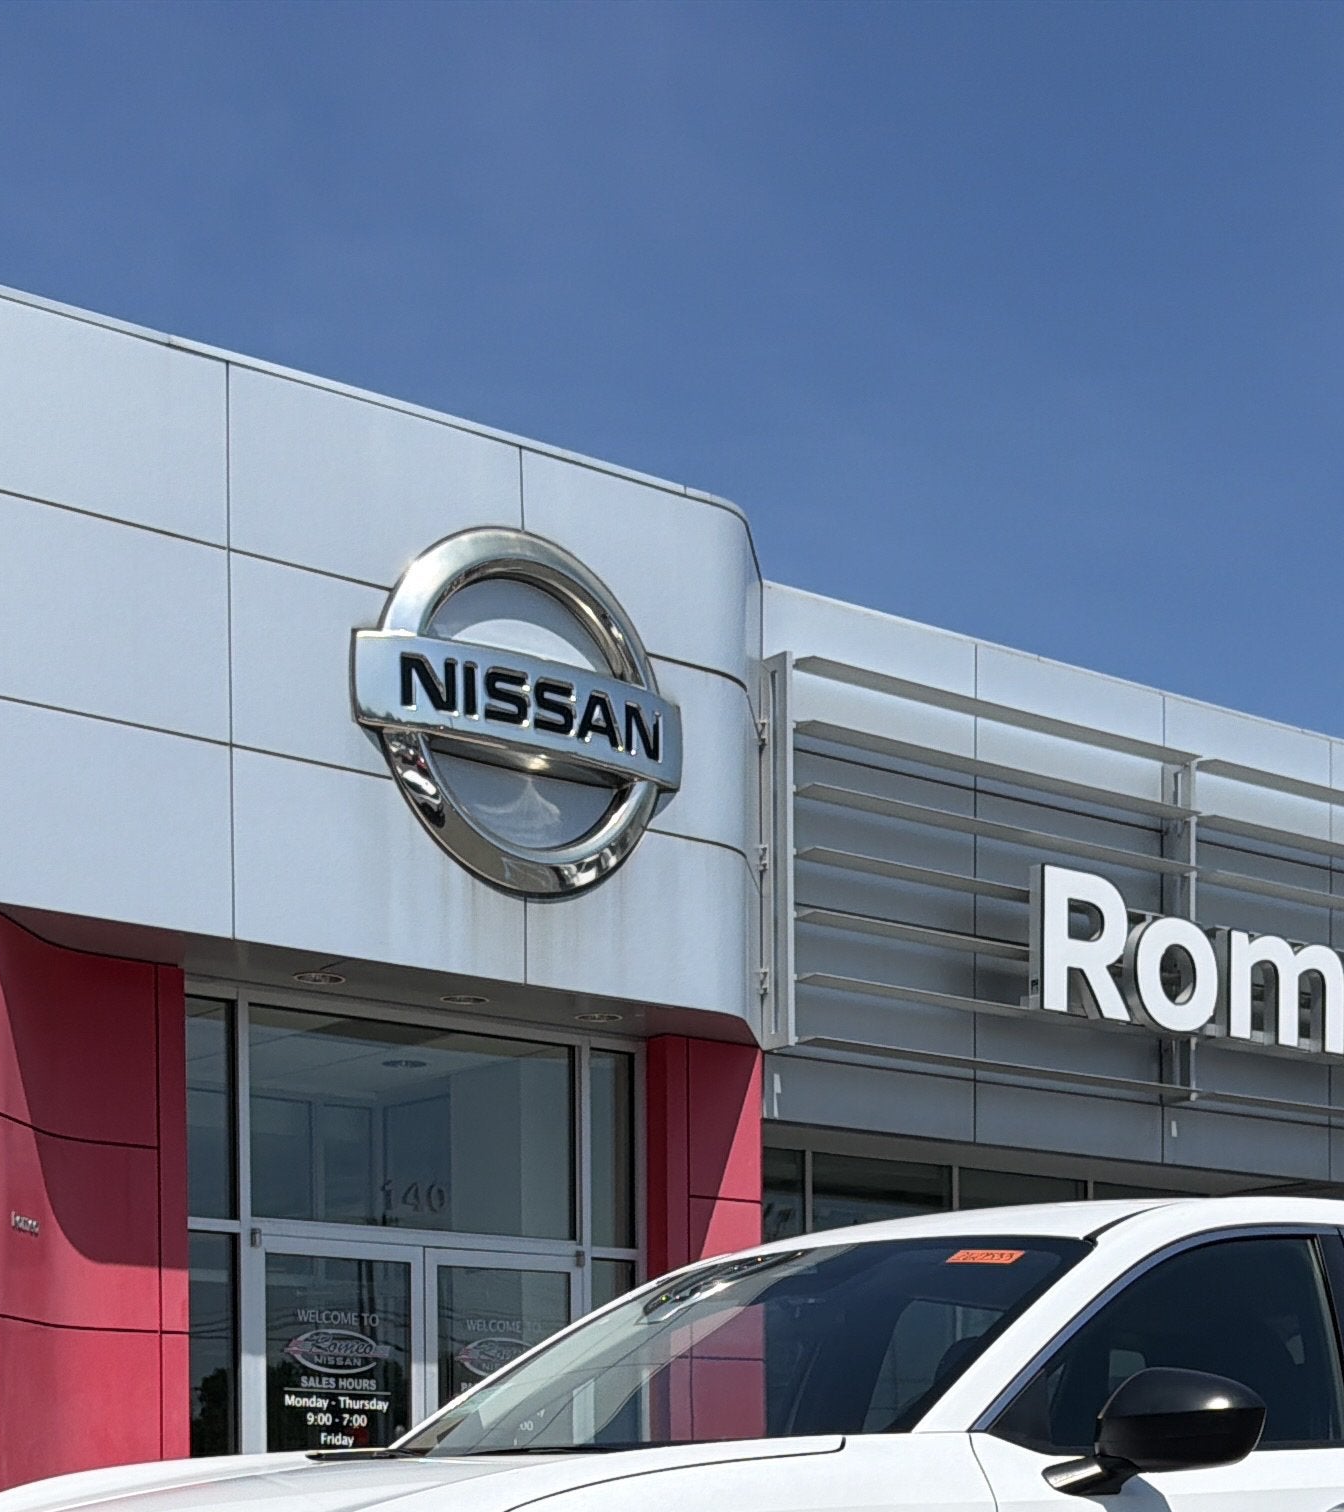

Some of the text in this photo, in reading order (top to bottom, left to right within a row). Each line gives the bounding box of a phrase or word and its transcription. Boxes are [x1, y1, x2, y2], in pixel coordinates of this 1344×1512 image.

[400, 651, 663, 764] NISSAN
[381, 1180, 445, 1213] 140
[297, 1309, 379, 1327] WELCOME TO
[467, 1320, 522, 1333] WELCOME
[314, 1355, 362, 1367] NISSAN
[301, 1376, 377, 1390] SALES HOURS
[285, 1394, 329, 1409] Monday
[338, 1396, 389, 1412] Thursday
[307, 1413, 332, 1426] 9:00
[342, 1414, 368, 1427] 7:00
[320, 1433, 354, 1447] Friday
